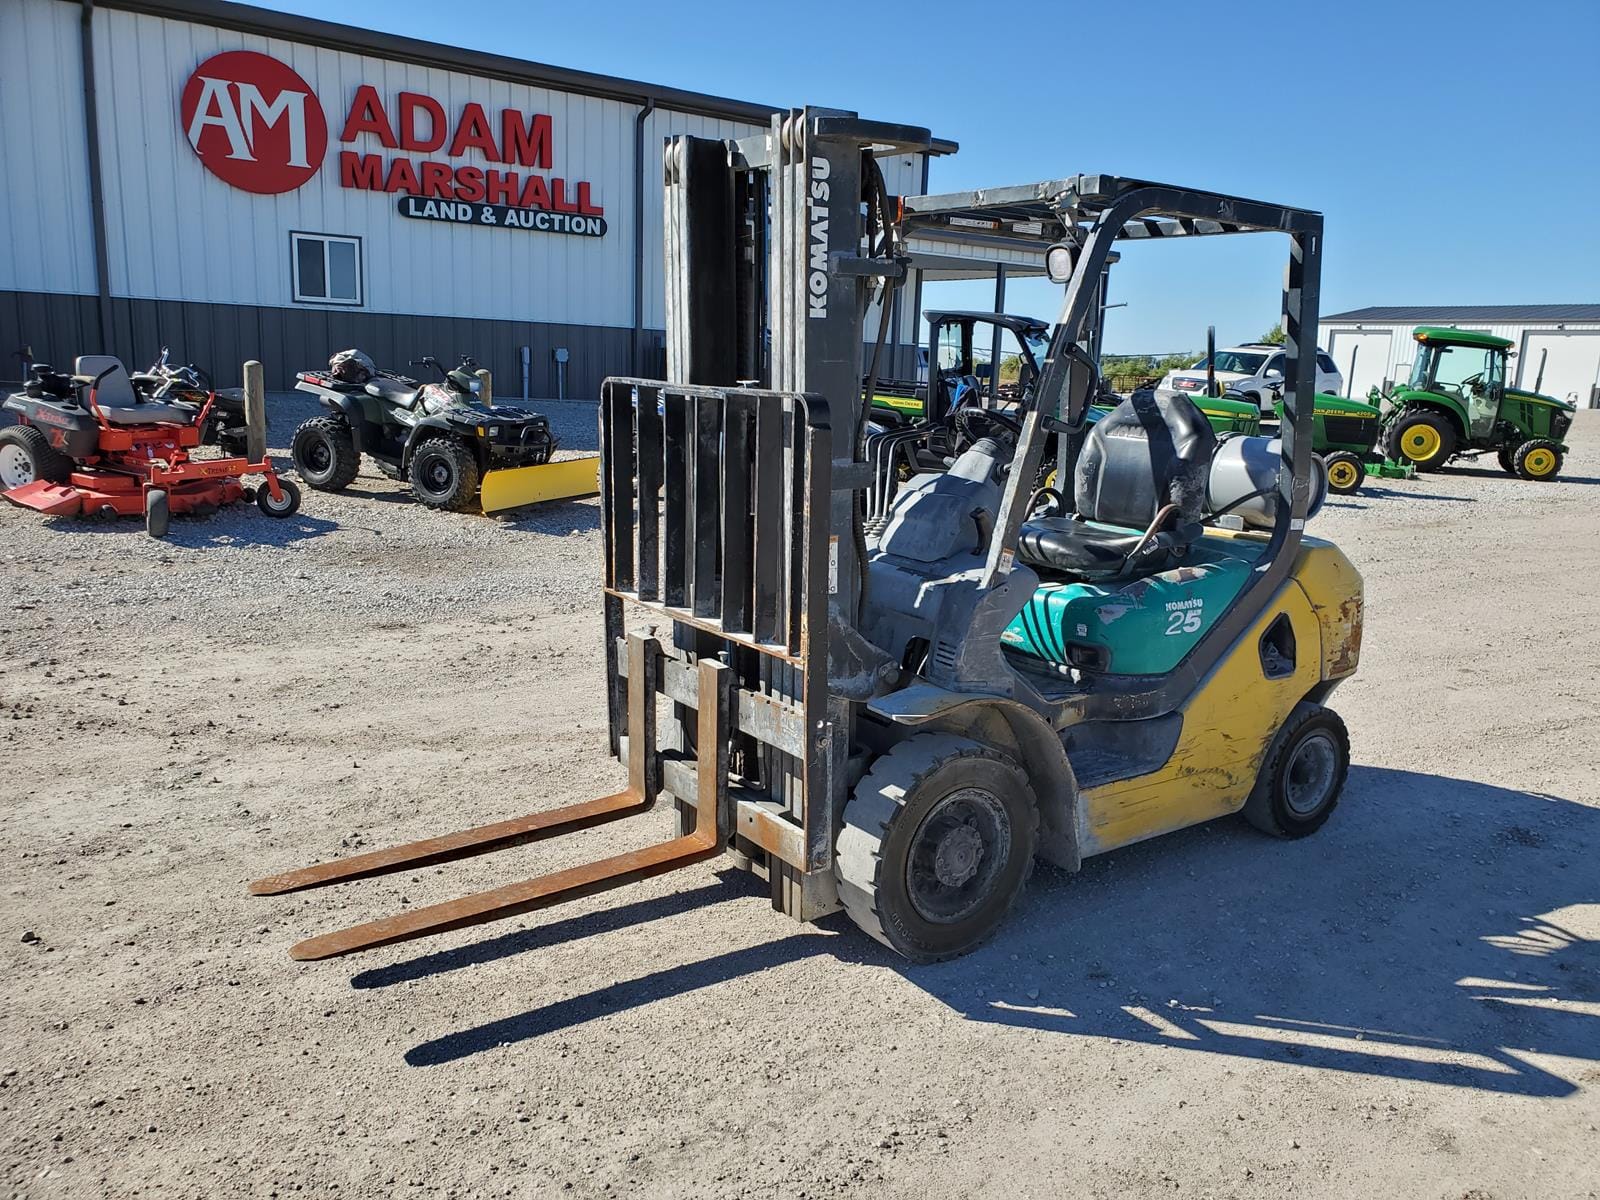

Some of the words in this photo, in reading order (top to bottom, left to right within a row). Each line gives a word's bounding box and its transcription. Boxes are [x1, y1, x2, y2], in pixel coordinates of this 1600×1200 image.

[187, 75, 312, 170] AM
[340, 84, 553, 169] ADAM
[339, 150, 604, 216] MARSHALL
[408, 198, 473, 222] LAND
[480, 206, 497, 225] &
[504, 209, 602, 235] AUCTION
[806, 156, 831, 319] KOMATSU
[1165, 597, 1204, 612] KOMATSU
[1165, 609, 1203, 635] 25
